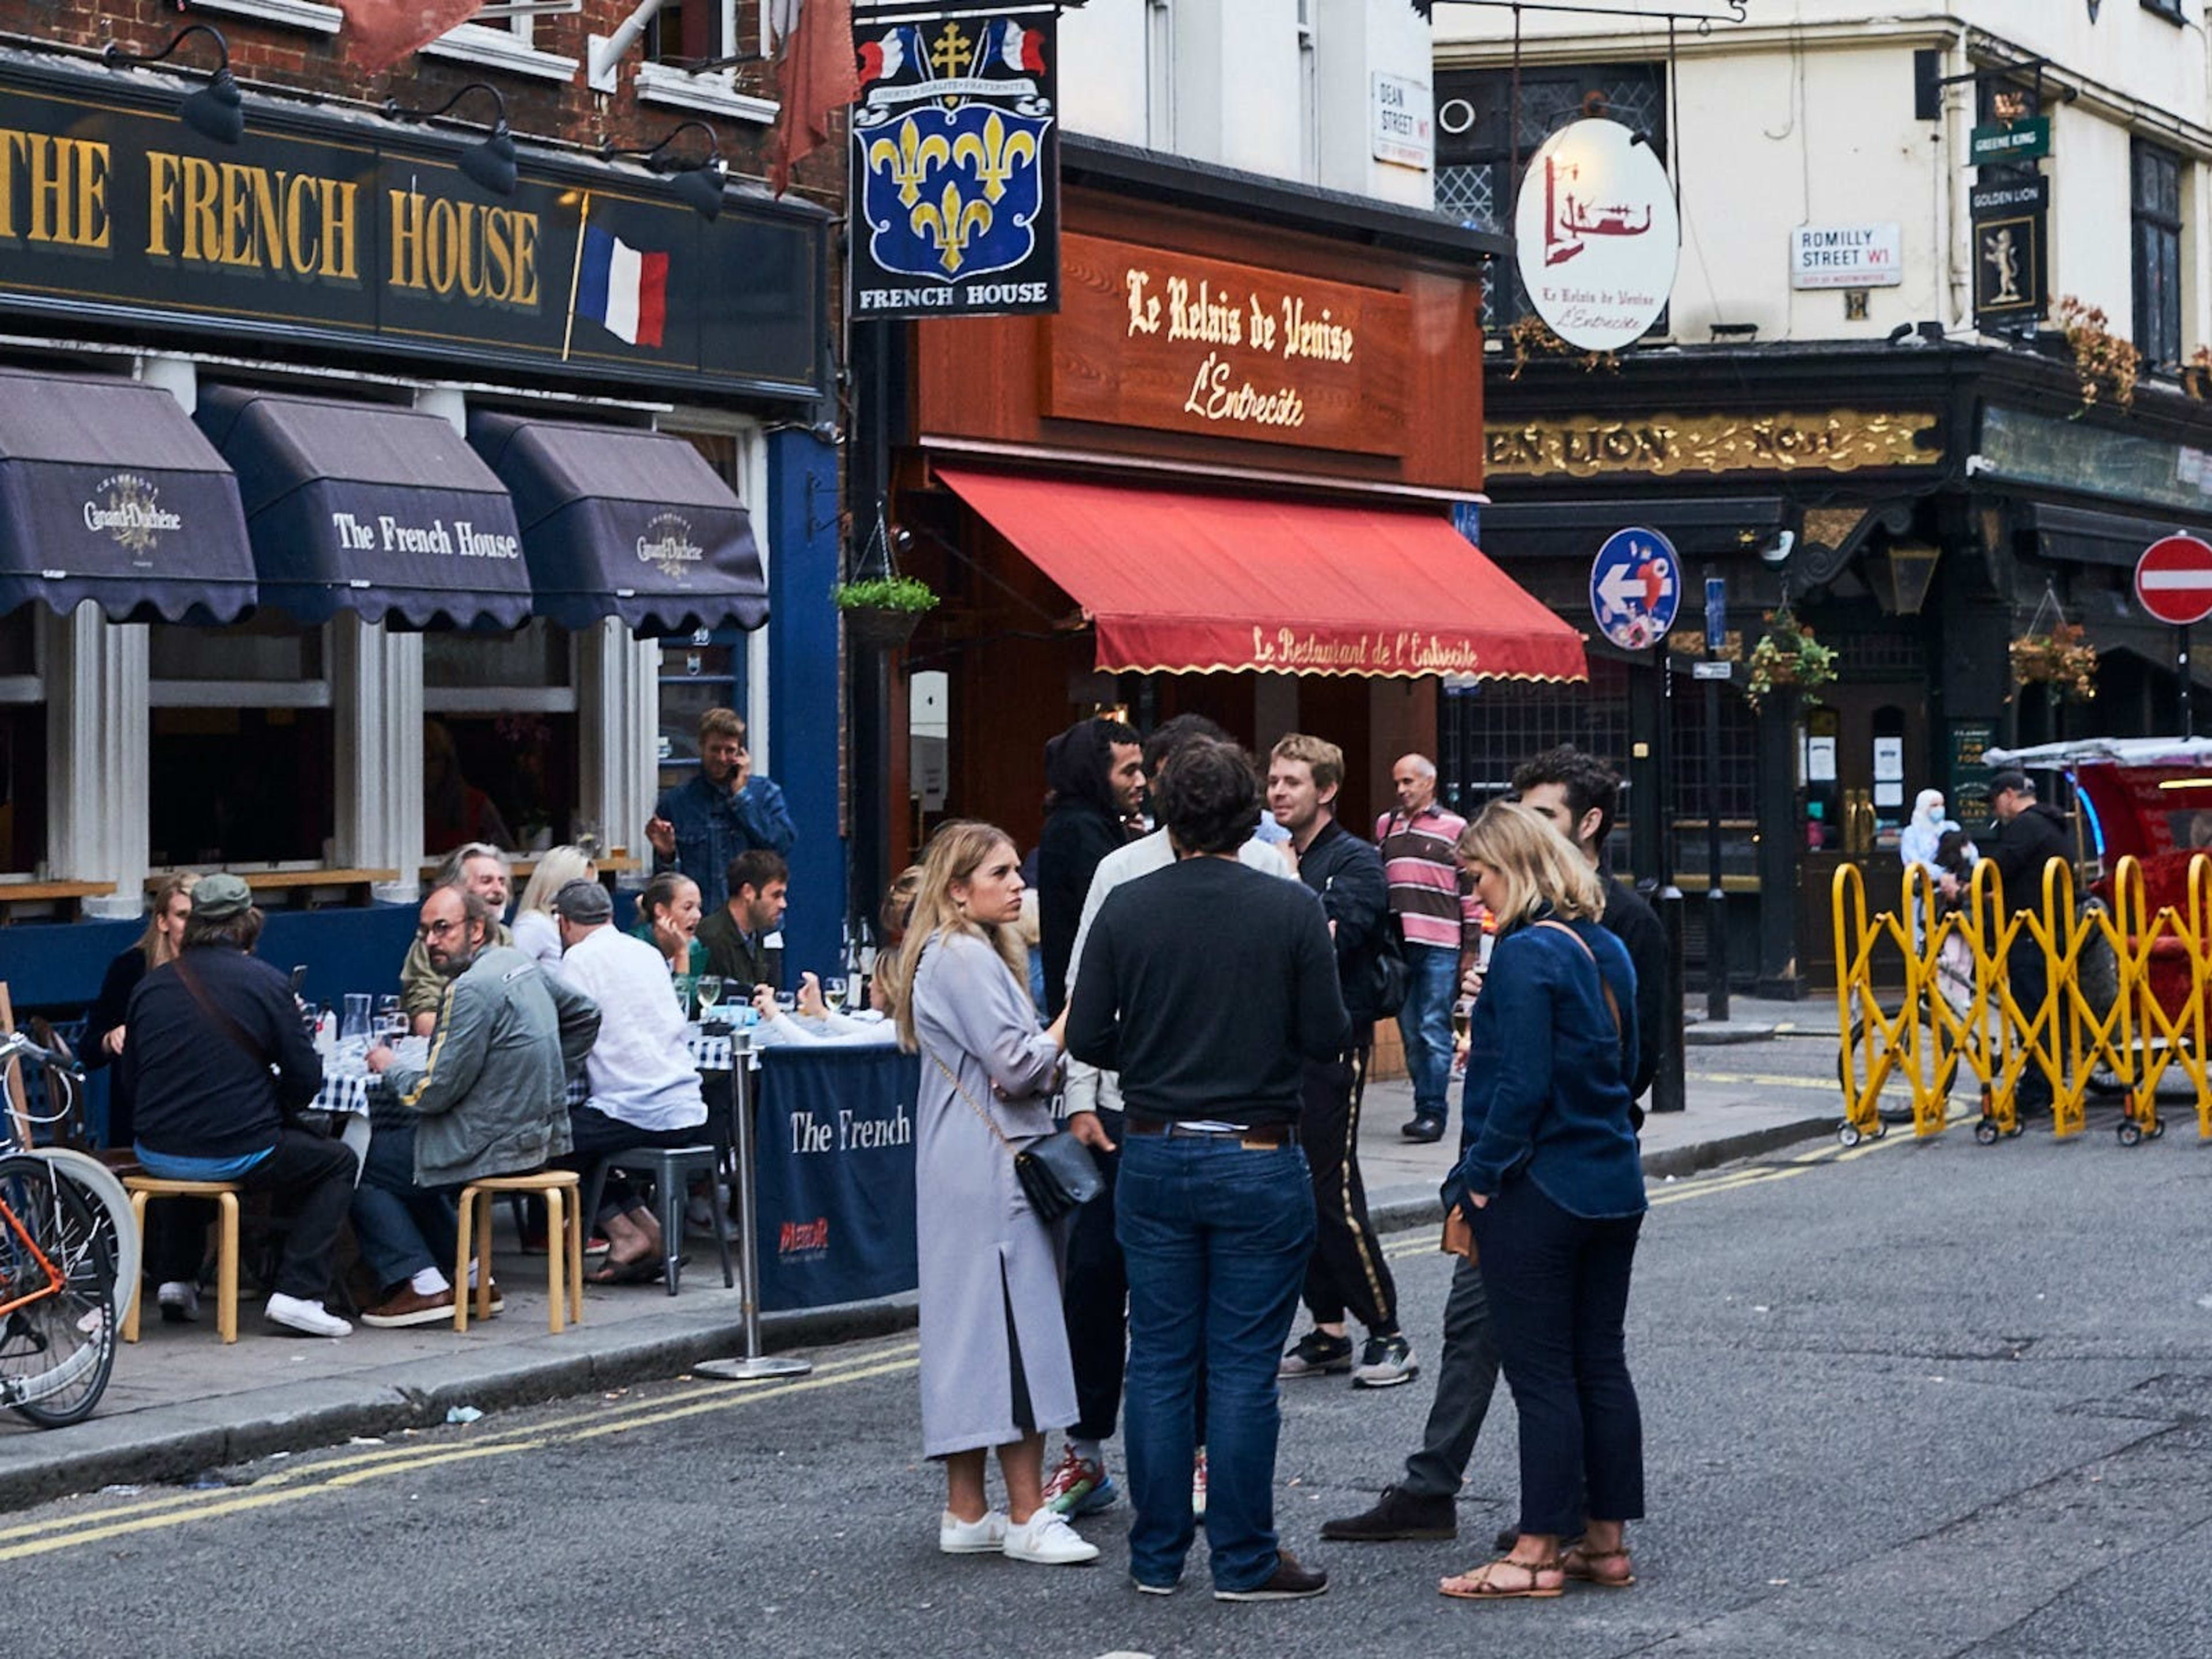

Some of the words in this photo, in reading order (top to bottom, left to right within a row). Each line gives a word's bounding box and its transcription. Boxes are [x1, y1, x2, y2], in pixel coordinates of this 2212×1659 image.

[0, 128, 110, 248] THE
[145, 150, 359, 280] FRENCH
[388, 188, 539, 306] HOUSE
[1974, 190, 2013, 208] GOLDEN
[2014, 187, 2039, 202] LION
[1802, 230, 1873, 248] ROMILLY
[1802, 249, 1859, 267] STREET
[1868, 248, 1889, 264] W1
[859, 287, 954, 309] FRENCH
[966, 282, 1048, 305] HOUSE
[1127, 268, 1162, 338] Le
[1166, 276, 1242, 346] Relais
[1249, 293, 1277, 353] de
[1282, 295, 1354, 364] Venise
[332, 512, 376, 550] The
[377, 515, 454, 554] French
[453, 521, 520, 559] House
[1253, 625, 1275, 662] Le
[1372, 631, 1391, 666] de
[790, 1111, 833, 1153] The
[838, 1104, 911, 1151] French
